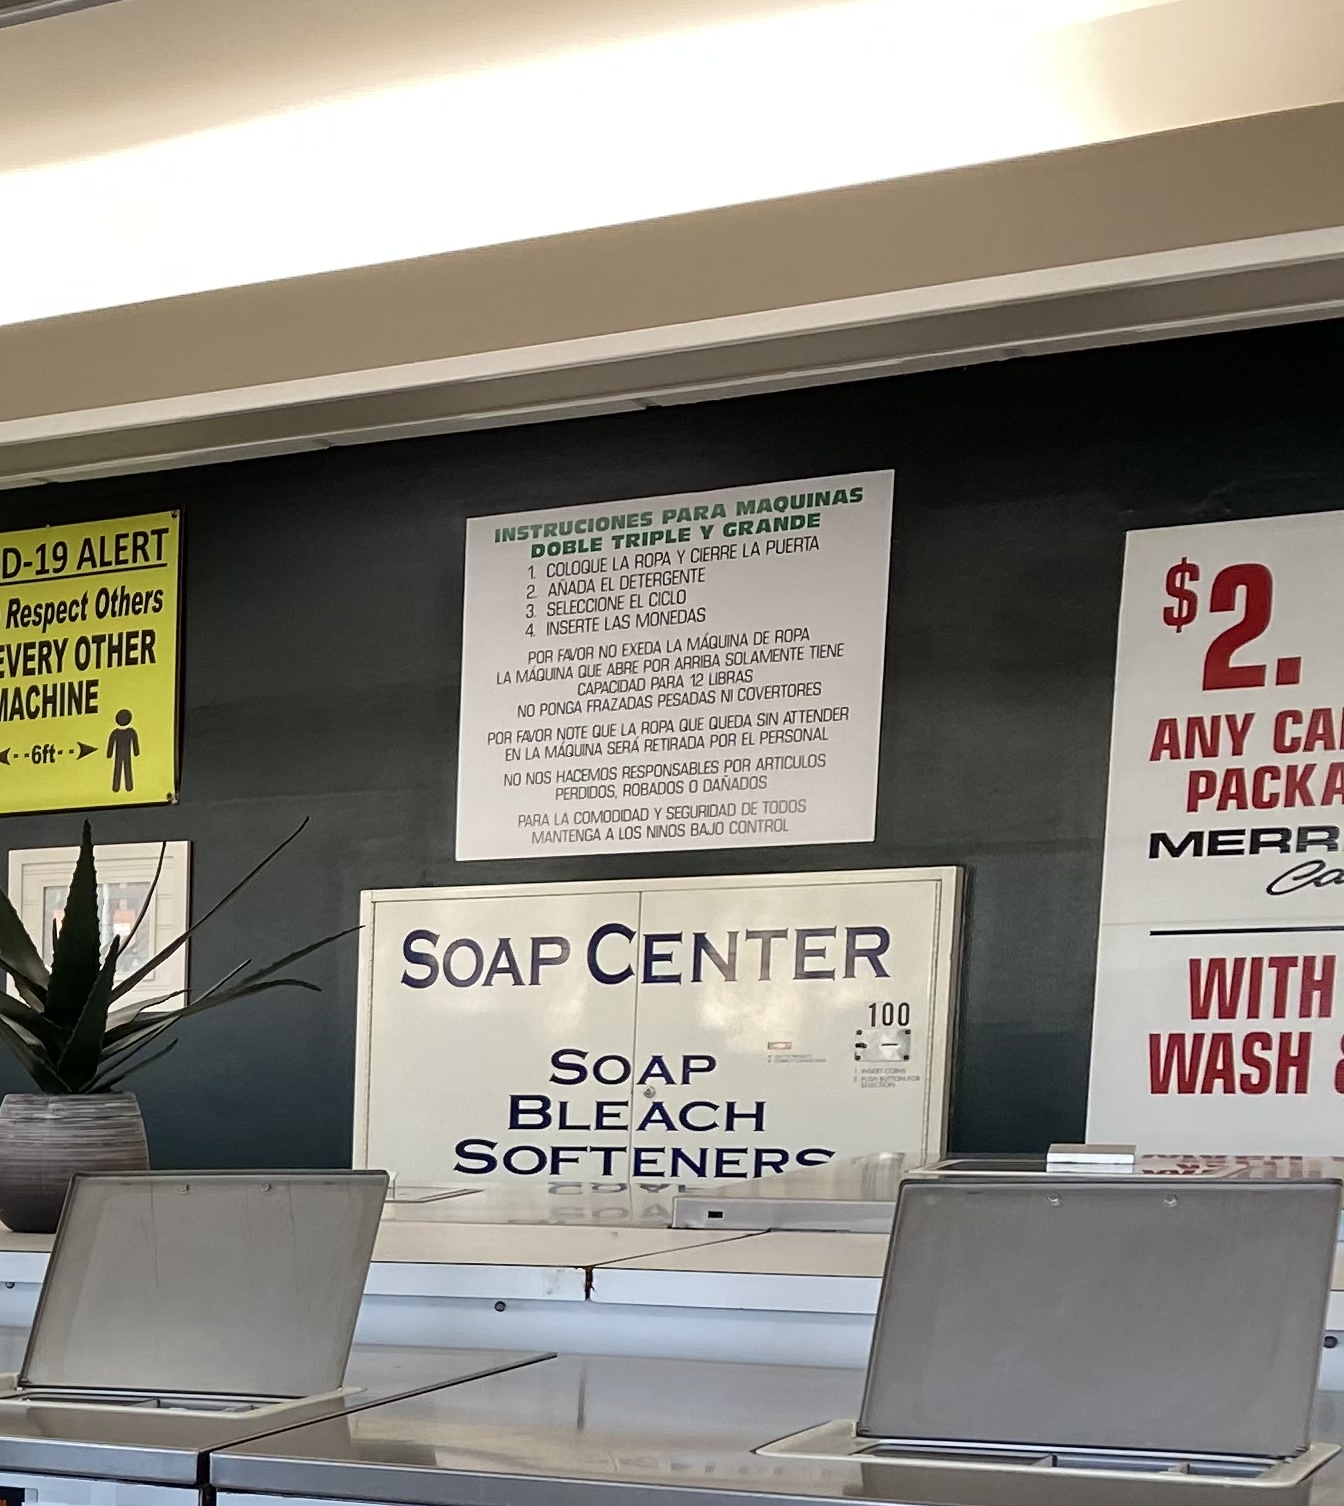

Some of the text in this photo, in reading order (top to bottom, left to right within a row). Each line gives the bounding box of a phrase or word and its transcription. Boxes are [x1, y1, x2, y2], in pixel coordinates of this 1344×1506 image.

[494, 486, 863, 543] INSTRUCIONES PARA MAQUINAS
[530, 512, 820, 558] DOBLE TRIPLE Y GRANDE
[76, 527, 169, 570] ALERT
[527, 535, 819, 579] 1. COLOQUE LA ROPA Y CIERRE LA PUERTA
[525, 588, 686, 618] 3. SELECCIONE EL CICLO
[526, 566, 706, 599] 2. AÑADA EL DETERGENTE
[6, 591, 89, 633] Respect
[95, 585, 164, 618] Others
[524, 606, 706, 637] 4. INSERTE LAS MONEDAS
[74, 629, 156, 671] OTHER
[1149, 707, 1344, 762] ANY CA
[1149, 825, 1344, 859] MERR
[401, 922, 891, 989] SOAP CENTER
[1189, 955, 1336, 1020] WITH
[868, 1002, 910, 1027] 100
[549, 1048, 717, 1086] SOAP
[1149, 1031, 1312, 1094] WASH
[508, 1094, 766, 1132] BLEACH
